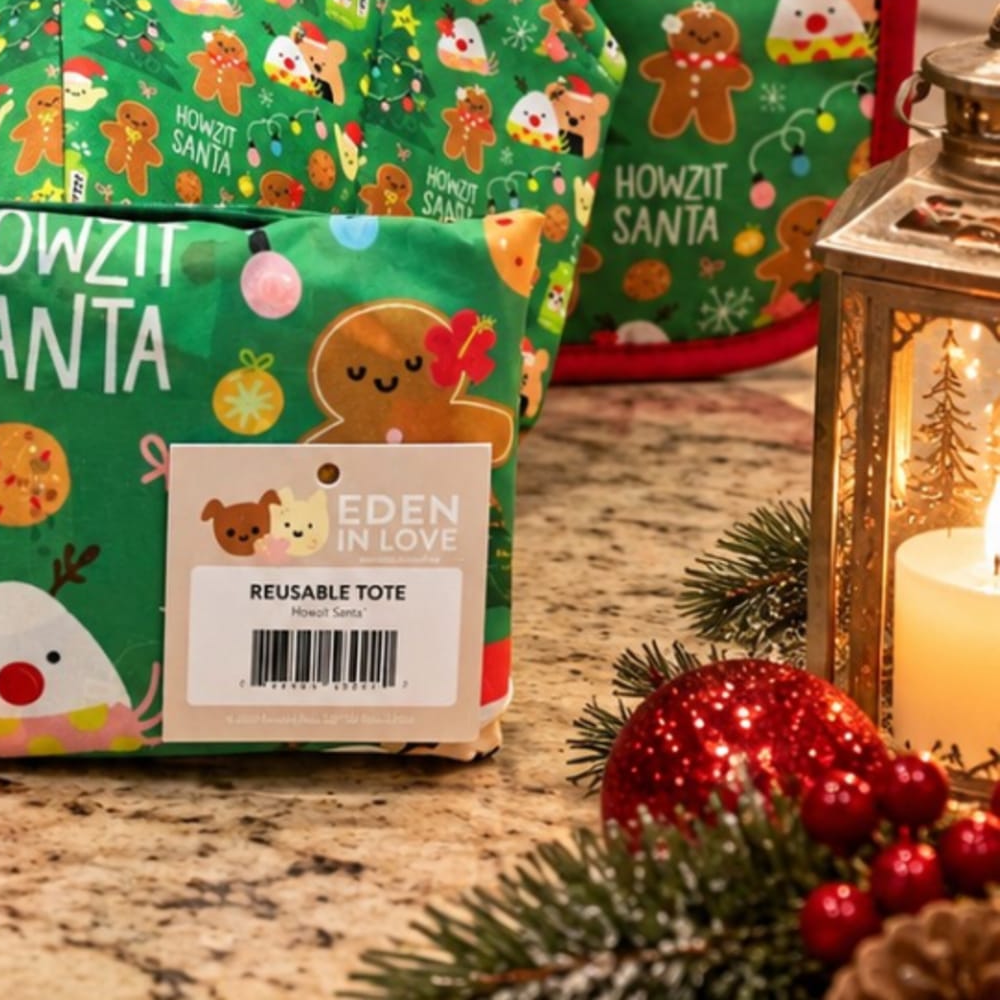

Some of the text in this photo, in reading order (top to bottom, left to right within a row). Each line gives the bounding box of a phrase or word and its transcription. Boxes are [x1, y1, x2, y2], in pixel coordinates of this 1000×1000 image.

[175, 103, 237, 149] HOWZIT
[171, 128, 231, 174] SANTA
[615, 162, 729, 201] HOWZIT
[612, 204, 719, 247] SANTA
[338, 494, 460, 526] EDEN
[336, 527, 458, 553] IN LOVE
[249, 583, 407, 602] REUSABLE TOTE
